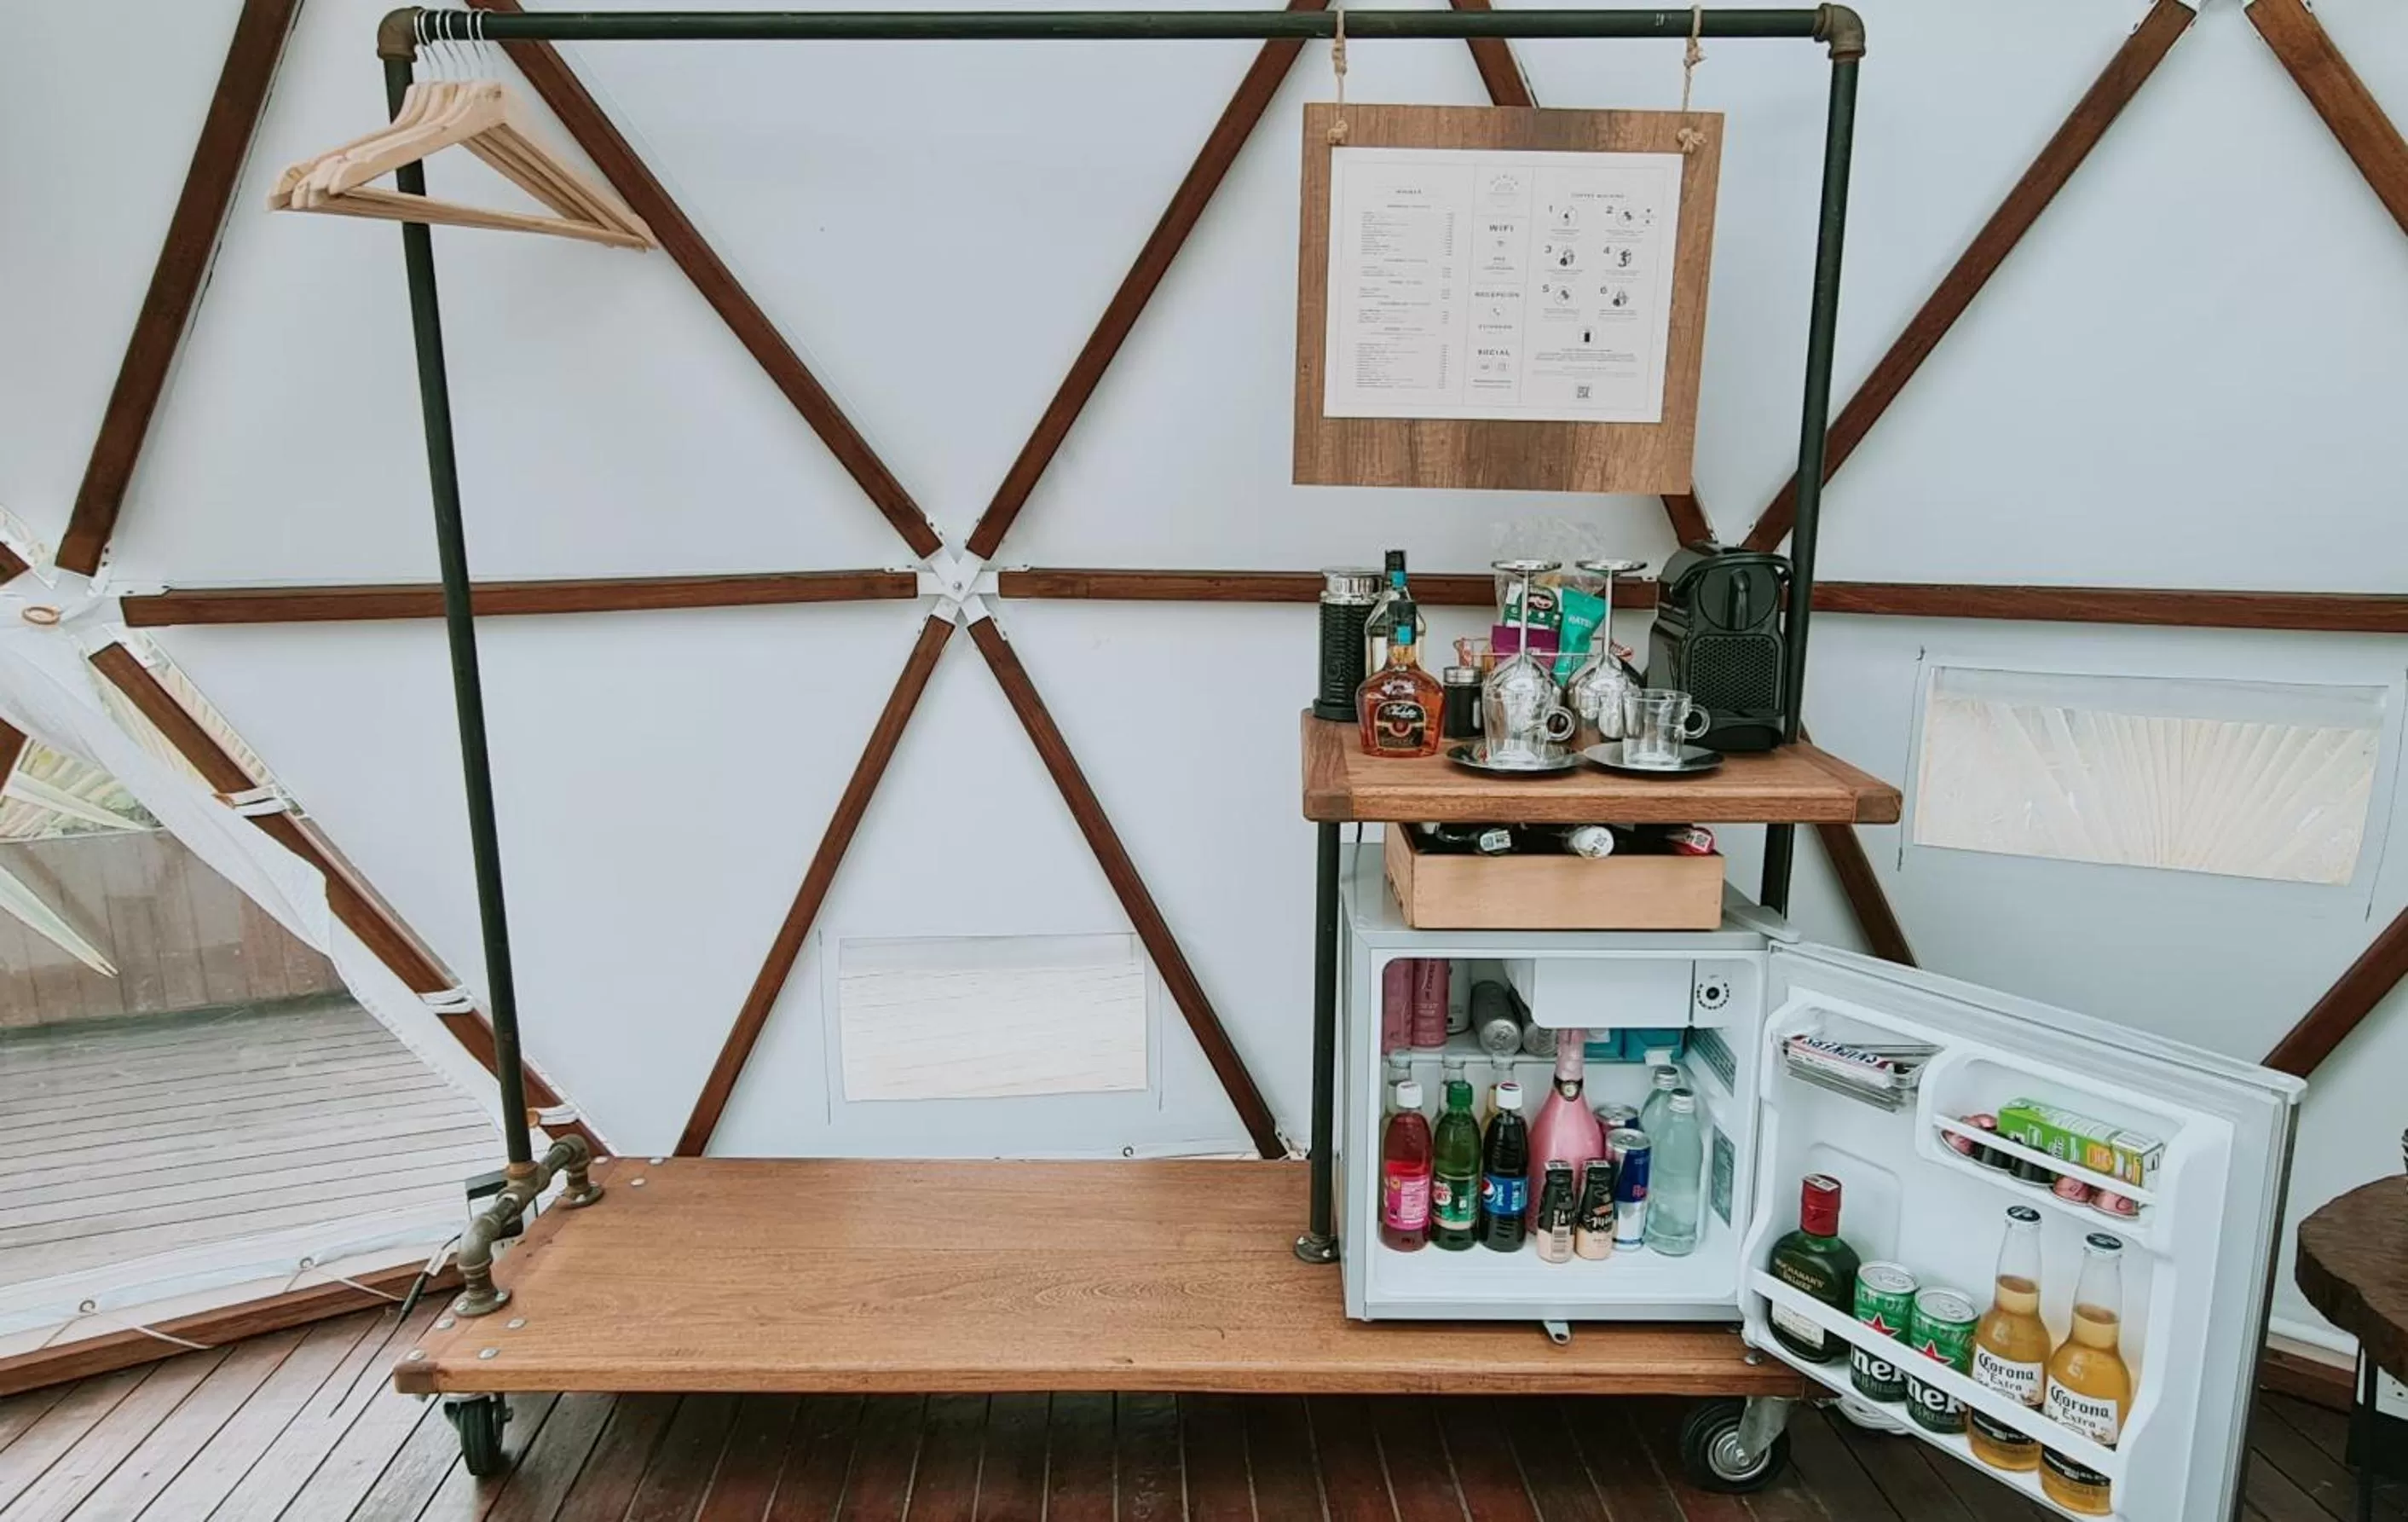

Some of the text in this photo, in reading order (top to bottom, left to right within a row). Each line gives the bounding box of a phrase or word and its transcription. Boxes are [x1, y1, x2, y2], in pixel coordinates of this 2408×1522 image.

[1978, 1352, 2034, 1380] Corona
[1989, 1372, 2022, 1392] Extra
[2051, 1385, 2109, 1418] Corona
[2062, 1407, 2096, 1429] Extra
